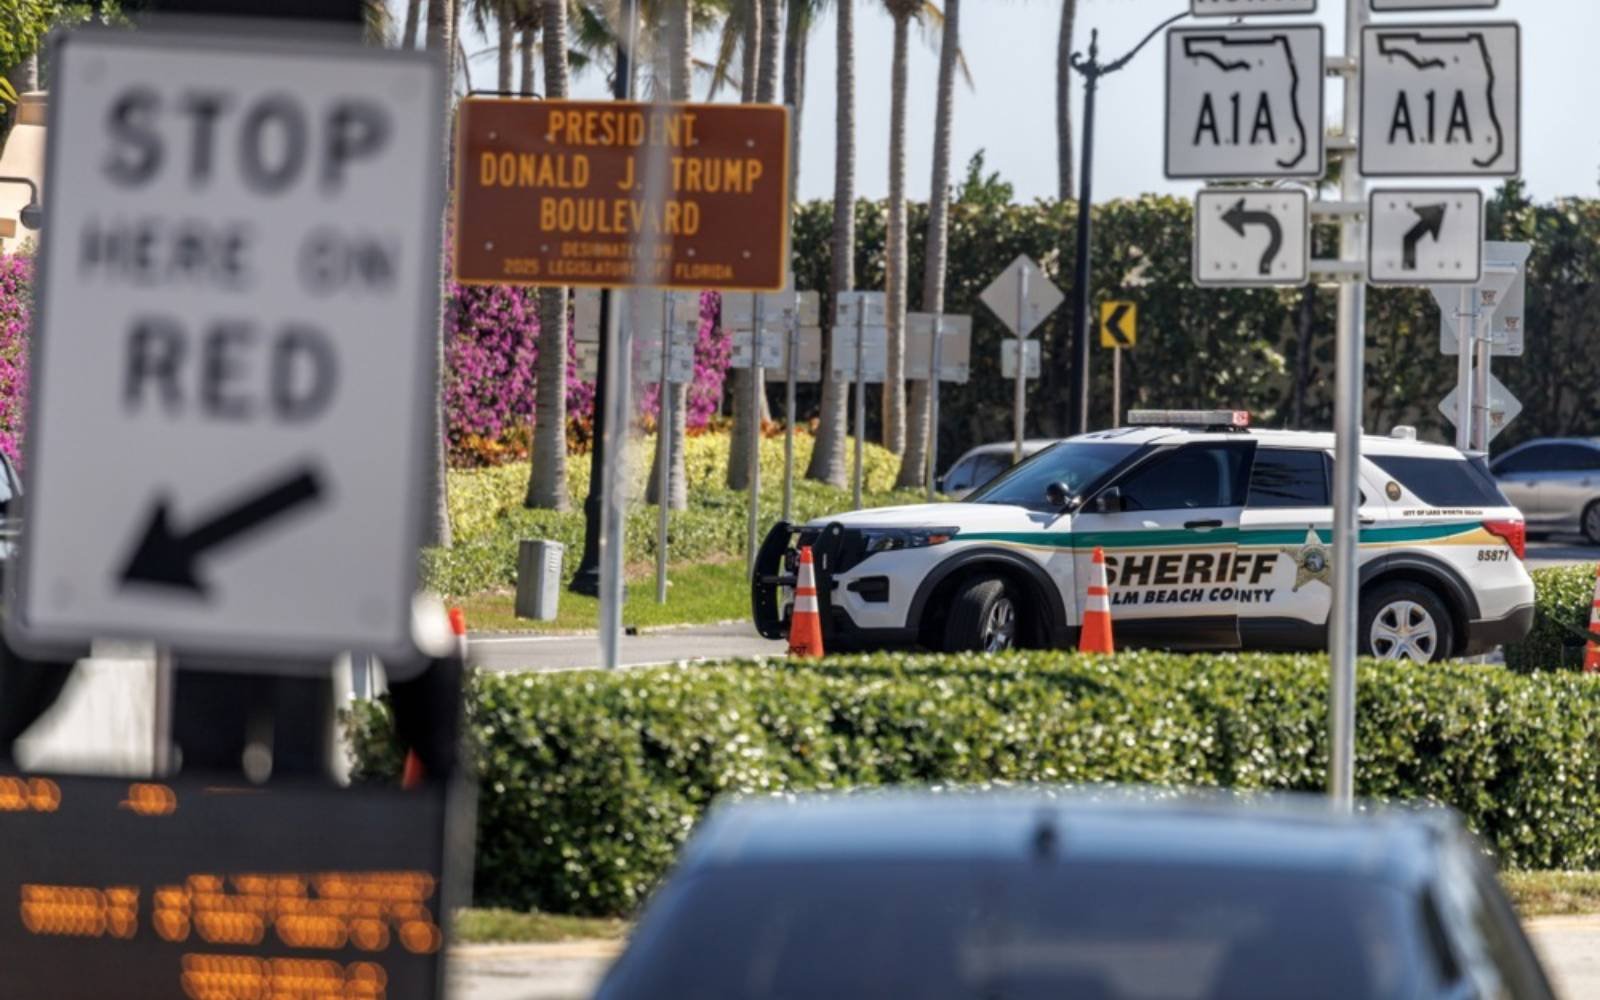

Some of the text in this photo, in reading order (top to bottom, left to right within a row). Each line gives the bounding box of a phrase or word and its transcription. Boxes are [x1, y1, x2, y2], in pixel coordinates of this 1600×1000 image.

[1193, 91, 1277, 146] A1A
[1388, 89, 1472, 145] A1A
[101, 87, 393, 194] STOP
[479, 152, 763, 193] DONALD J. TRUMP
[79, 216, 400, 299] HERE ON
[504, 258, 539, 275] 2025
[675, 263, 734, 279] FLORIDA
[562, 242, 645, 258] DESIGNATE
[121, 315, 341, 421] RED
[1104, 552, 1278, 587] SHERIFF
[1477, 549, 1509, 562] 85871
[1108, 590, 1140, 605] LM
[1143, 588, 1204, 605] BEACH
